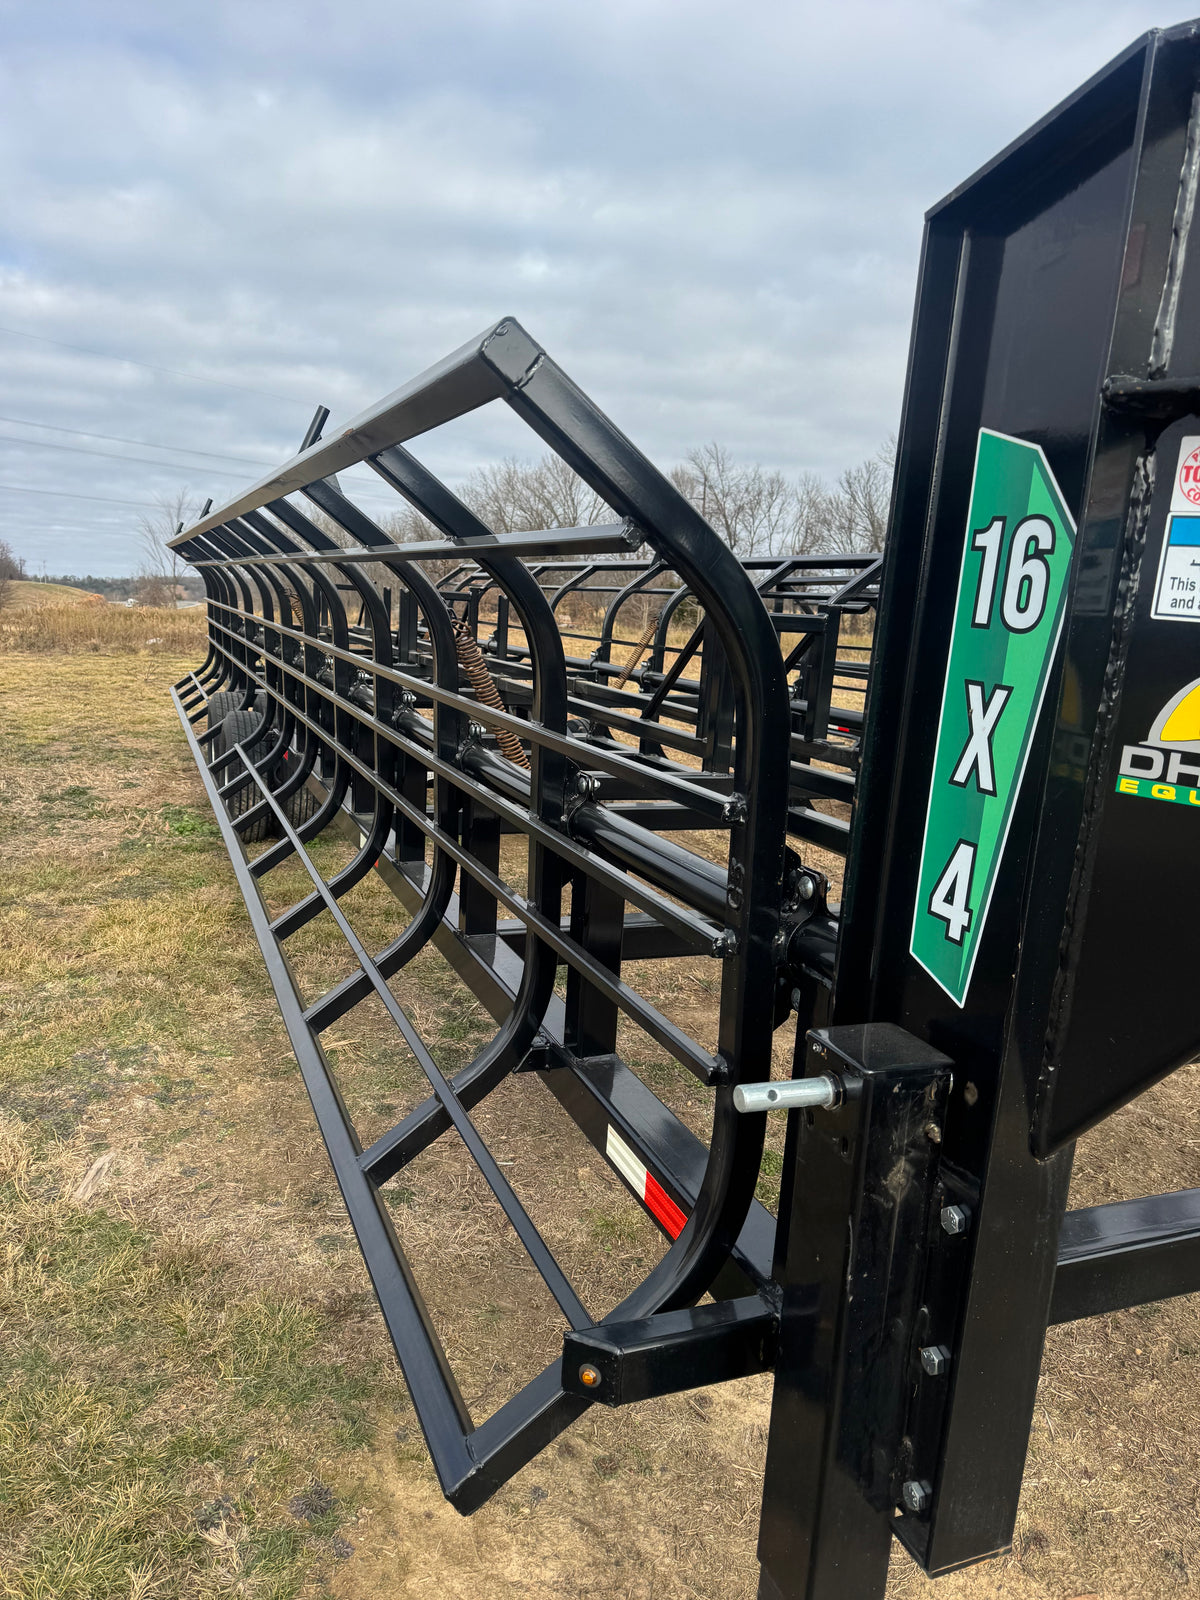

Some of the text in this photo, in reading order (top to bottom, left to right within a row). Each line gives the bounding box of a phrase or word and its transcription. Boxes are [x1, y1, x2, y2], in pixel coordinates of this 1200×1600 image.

[1169, 576, 1197, 592] This
[1170, 596, 1195, 610] and
[928, 514, 1056, 945] 16 X 4
